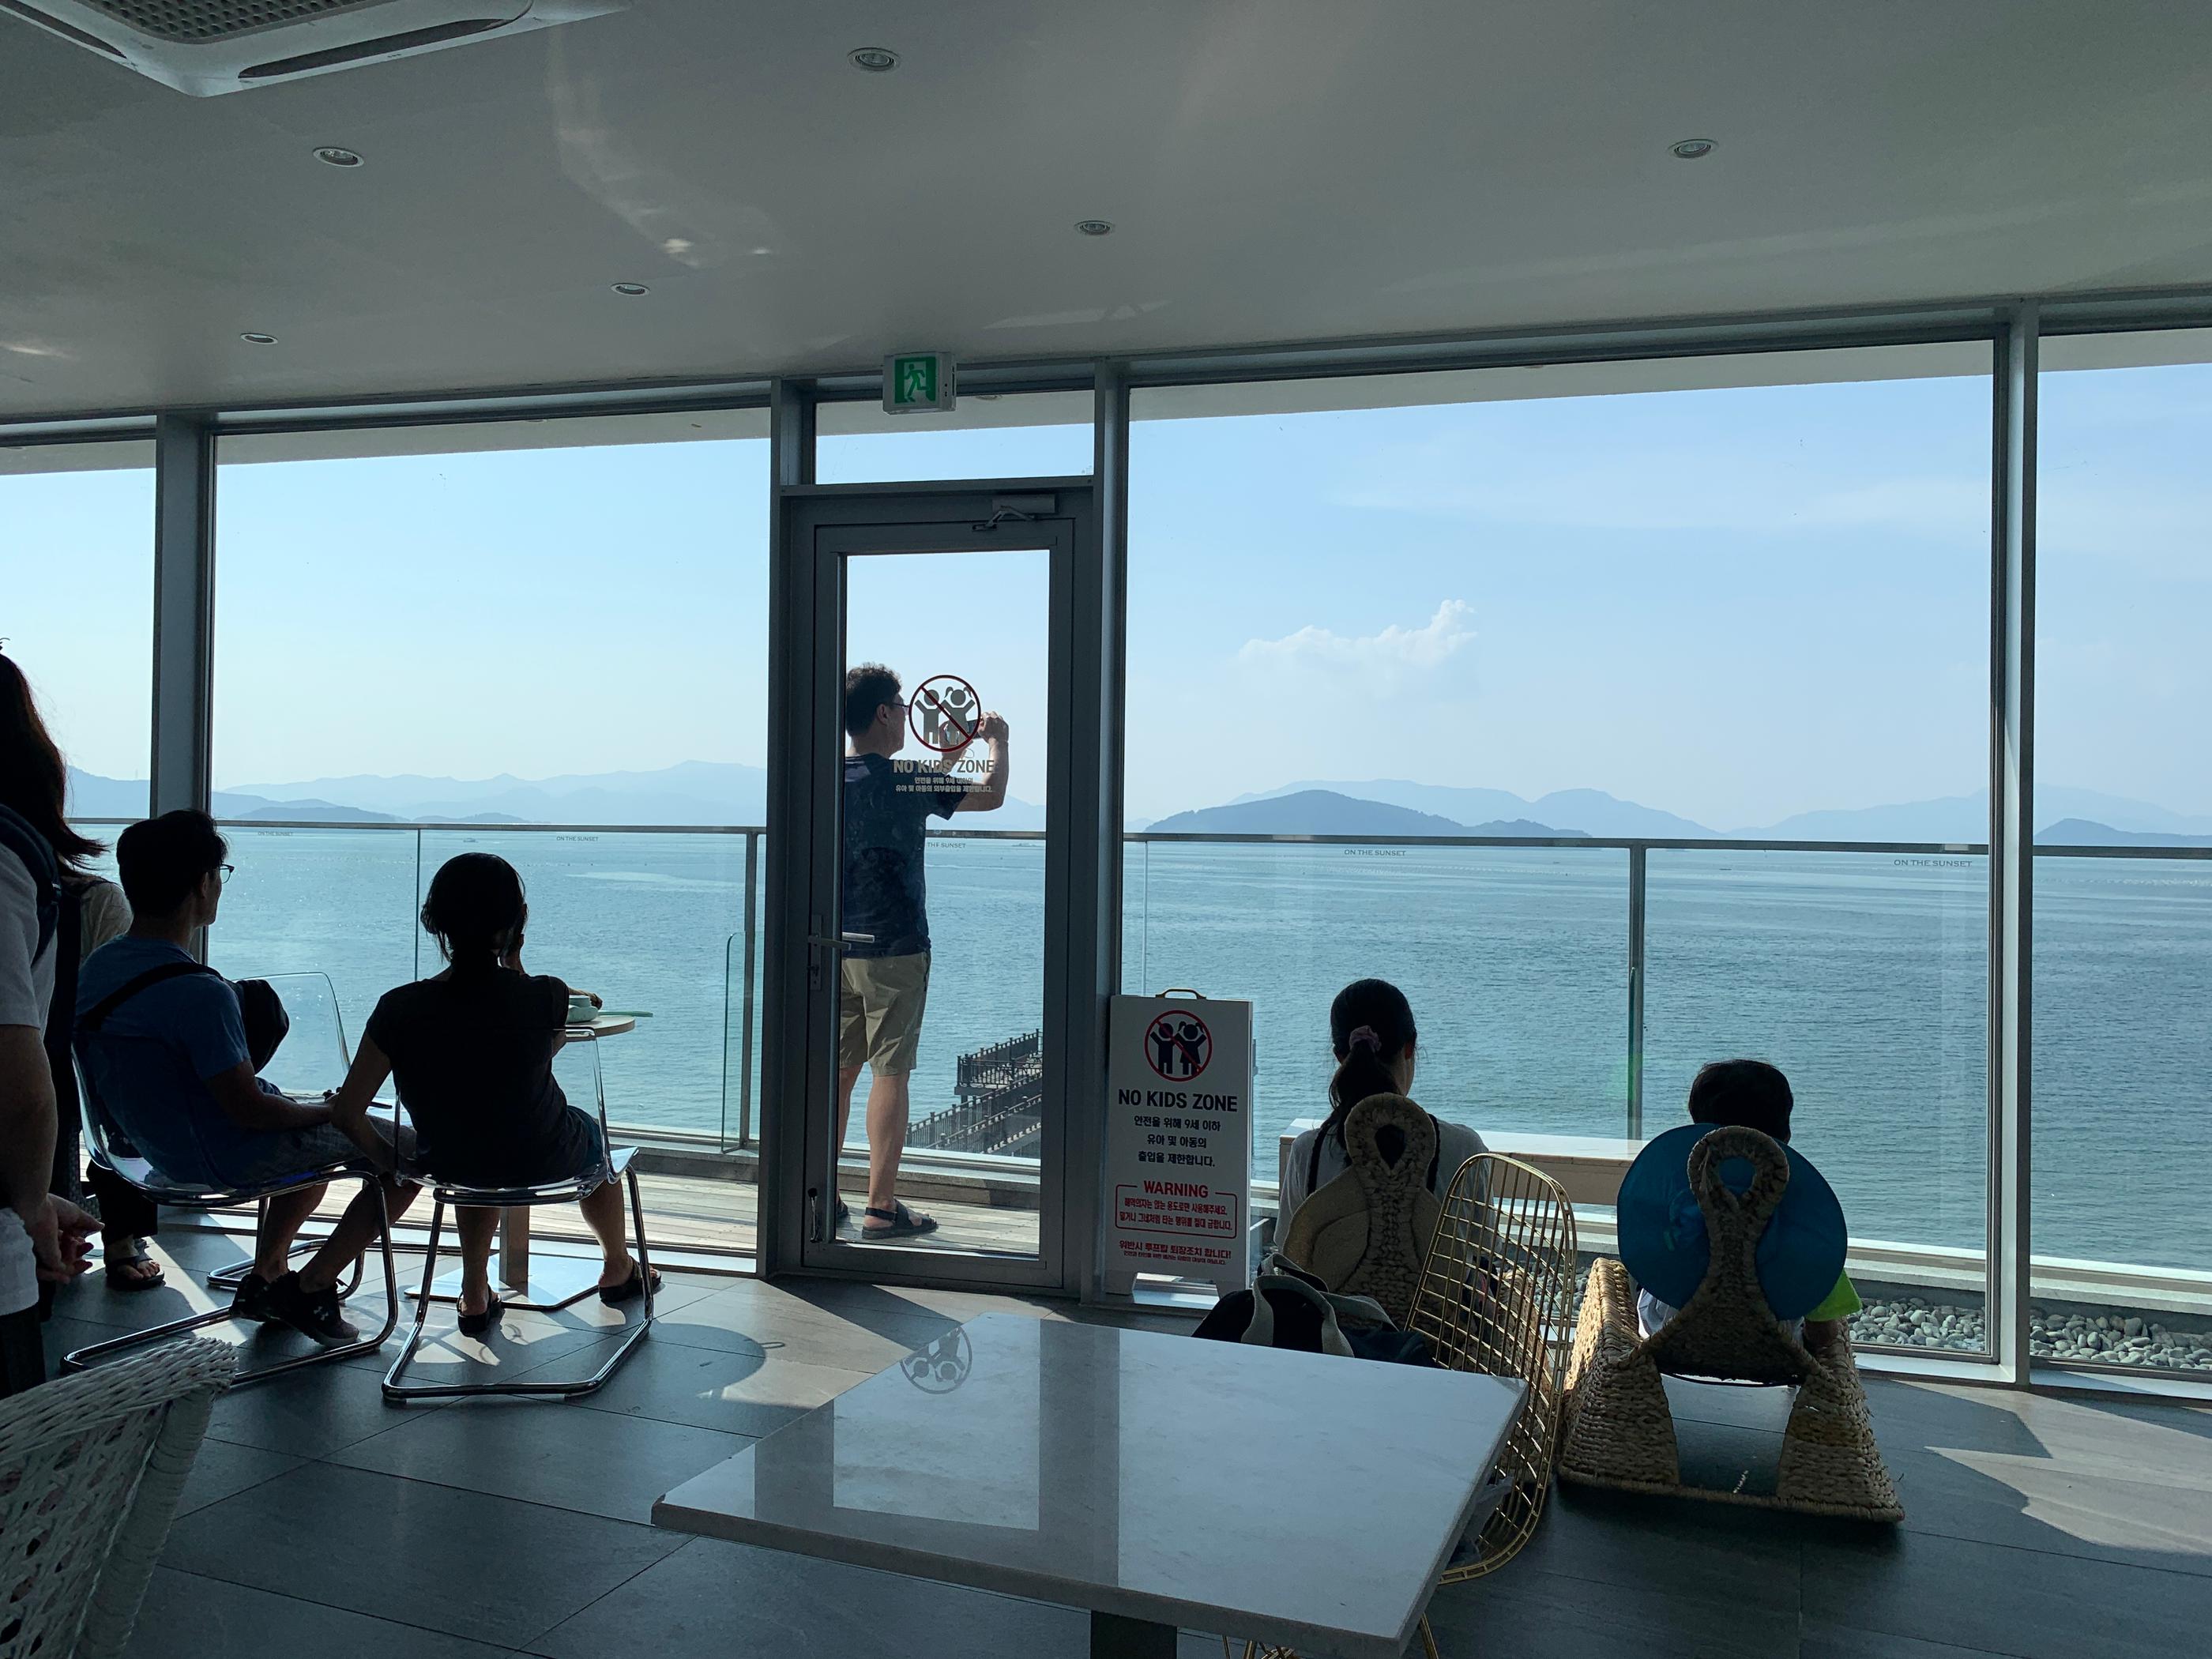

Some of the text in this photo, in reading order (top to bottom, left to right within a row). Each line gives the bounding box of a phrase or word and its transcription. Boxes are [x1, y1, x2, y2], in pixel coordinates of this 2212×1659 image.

[893, 759, 995, 774] NO KIDS ZONE
[1118, 1089, 1238, 1112] NO KIDS ZONE
[1134, 1115, 1221, 1132] 안전을 위해 9세 이하
[1147, 1134, 1207, 1149] 유아 및 아동의
[1138, 1151, 1216, 1168] 출입을 제한합니다.
[1144, 1180, 1209, 1198] WARNING
[1162, 1214, 1174, 1225] 타는
[1119, 1240, 1142, 1251] 위반시
[1170, 1245, 1202, 1256] 퇴장조치
[1204, 1247, 1232, 1259] 합니다!
